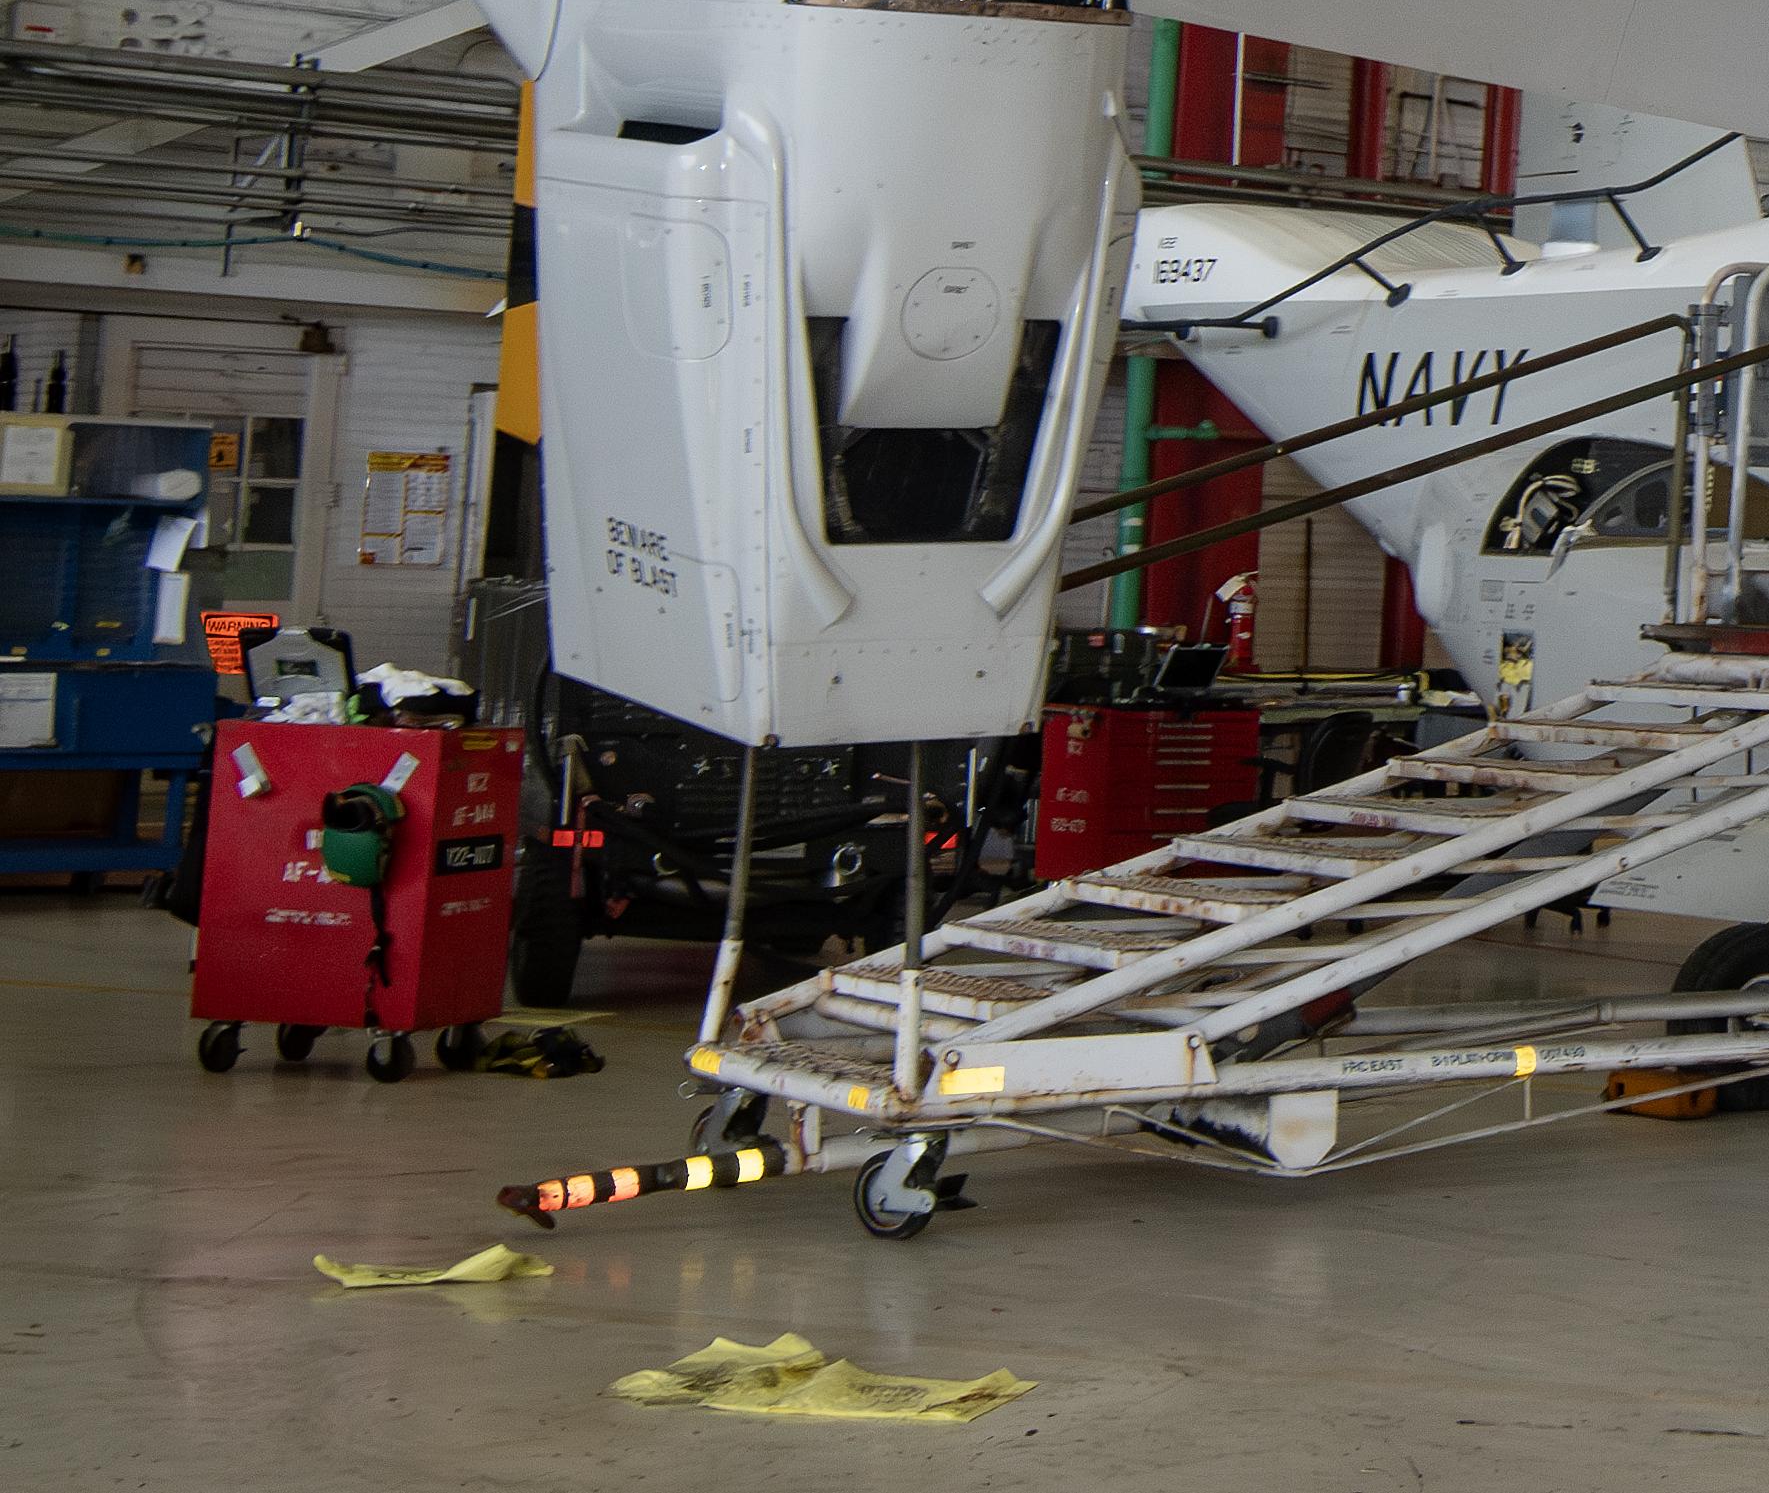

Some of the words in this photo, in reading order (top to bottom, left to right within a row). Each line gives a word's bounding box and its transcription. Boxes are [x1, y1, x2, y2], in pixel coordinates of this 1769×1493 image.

[1355, 348, 1530, 427] NAVY
[606, 516, 668, 562] BEWARE
[606, 548, 625, 577] OF
[629, 556, 678, 599] BLAST
